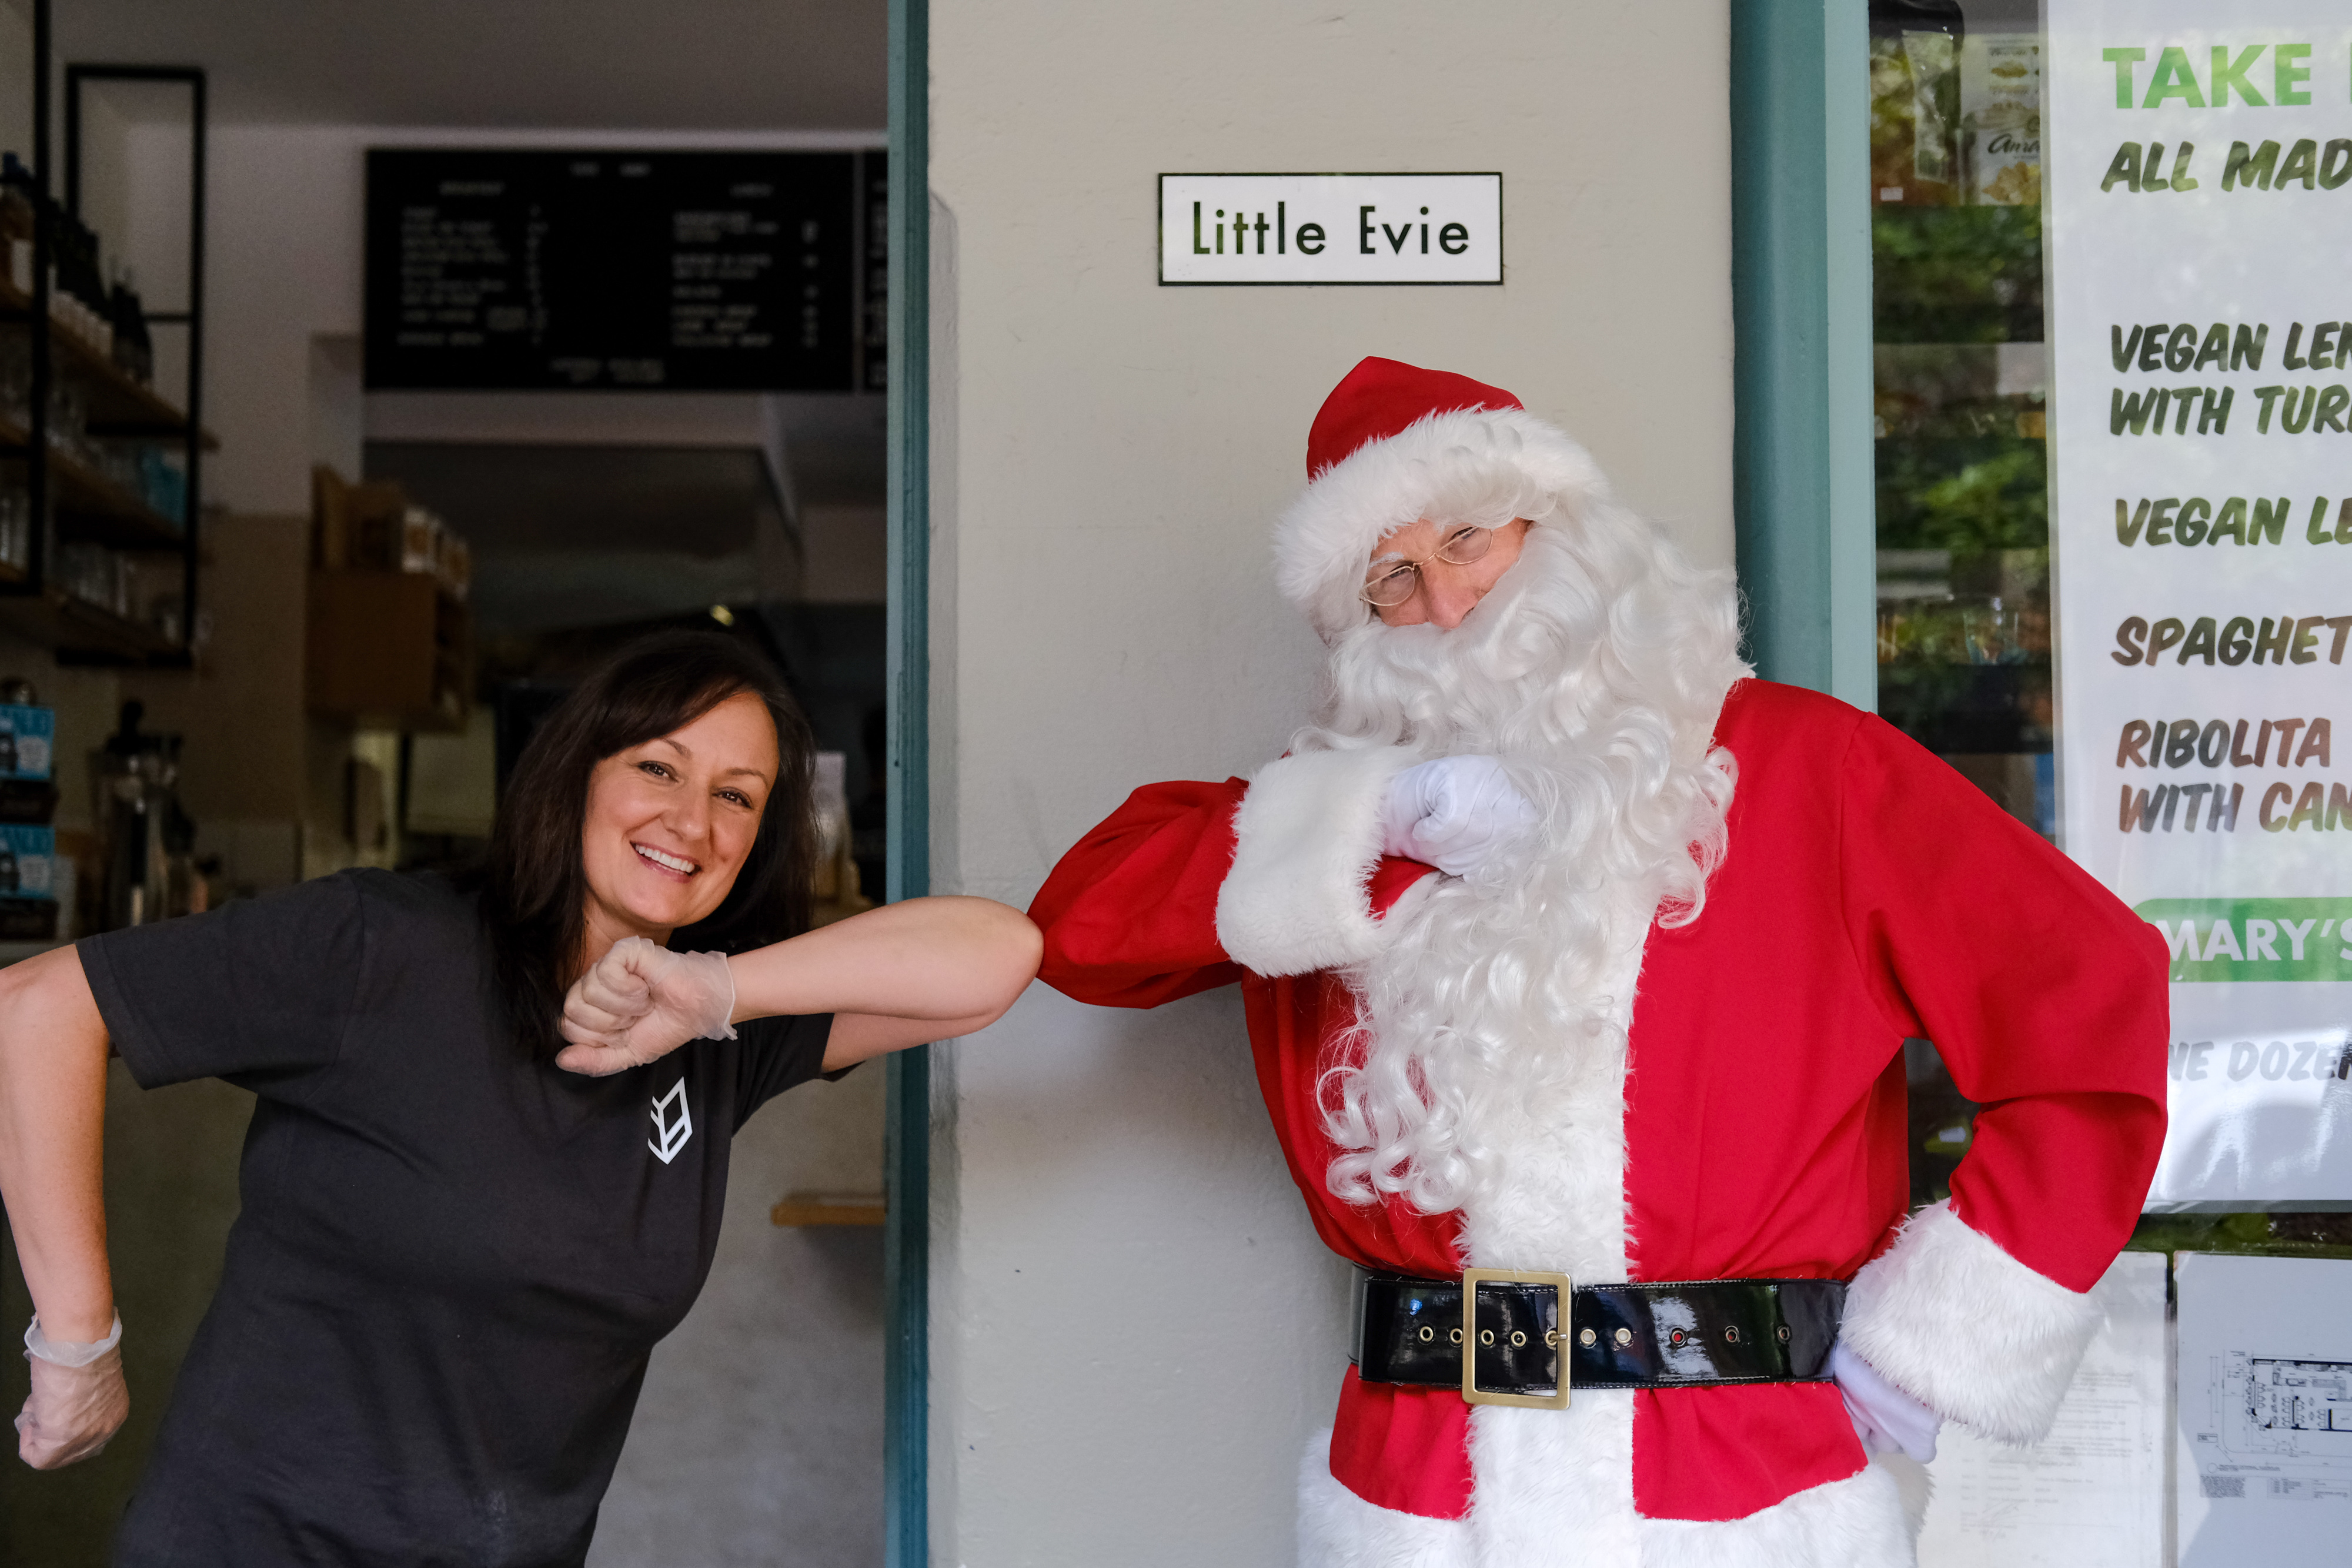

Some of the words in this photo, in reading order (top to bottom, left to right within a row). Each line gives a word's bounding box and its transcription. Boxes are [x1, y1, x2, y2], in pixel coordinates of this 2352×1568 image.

[2102, 44, 2312, 109] TAKE
[2101, 141, 2199, 193] ALL
[2221, 138, 2352, 193] MAD
[1194, 202, 1326, 255] Little
[1361, 206, 1469, 255] Evie
[2111, 323, 2269, 373] VEGAN
[2110, 385, 2234, 437] WITH
[2254, 384, 2352, 435] TUR
[2115, 496, 2291, 548] VEGAN
[2111, 615, 2352, 667] SPAGHET
[2116, 717, 2331, 769] RIBOLITA
[2119, 782, 2244, 834] WITH
[2167, 1041, 2215, 1082] NE
